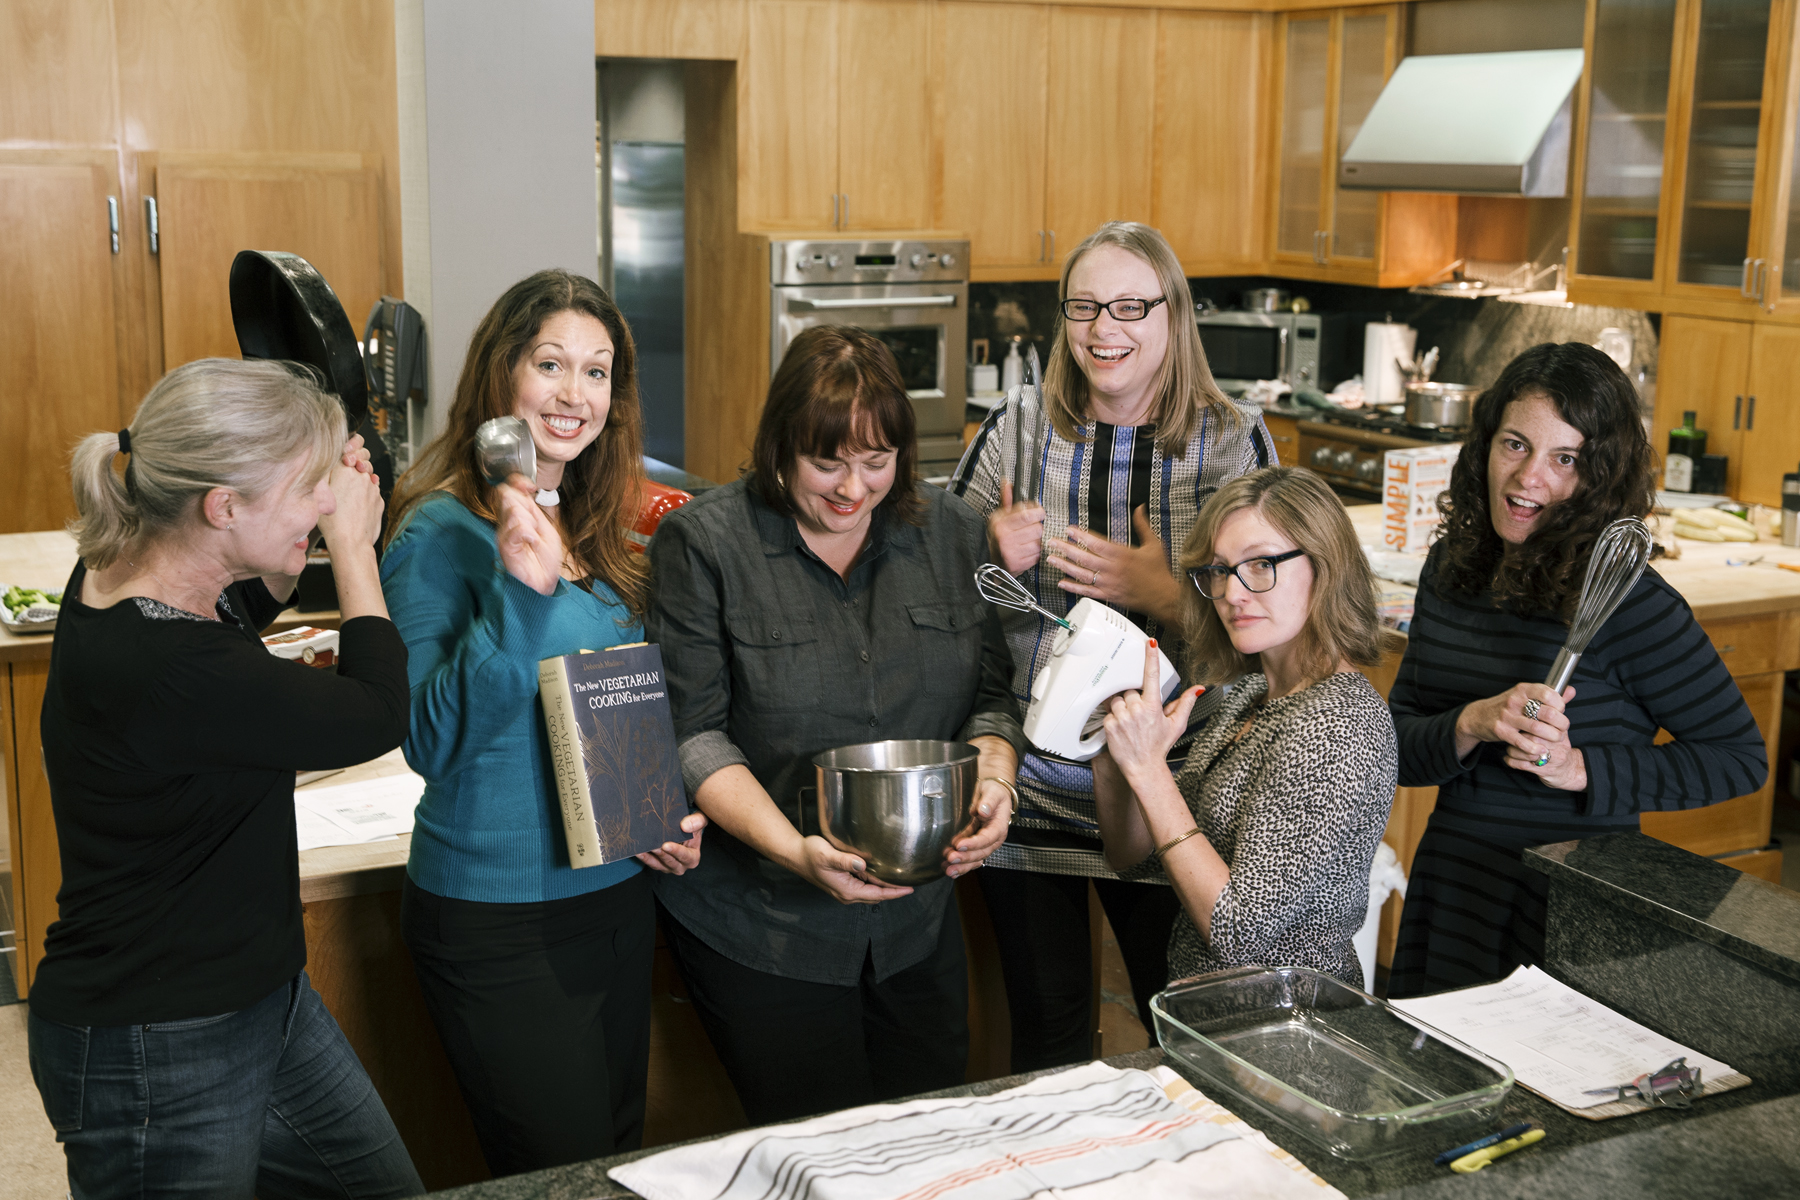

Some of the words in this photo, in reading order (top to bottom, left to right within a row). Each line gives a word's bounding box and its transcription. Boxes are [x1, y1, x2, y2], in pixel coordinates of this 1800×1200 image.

[1385, 459, 1410, 549] SIMPLE
[573, 682, 587, 693] The
[586, 681, 599, 691] New
[598, 671, 660, 692] VEGETARIAN
[555, 694, 563, 711] The
[588, 690, 633, 710] COOKING
[632, 695, 642, 703] for
[640, 690, 665, 702] Everyone
[558, 713, 566, 731] New
[548, 715, 566, 778] COOKING
[561, 792, 573, 831] Everyone
[561, 732, 585, 821] VEGETARIAN
